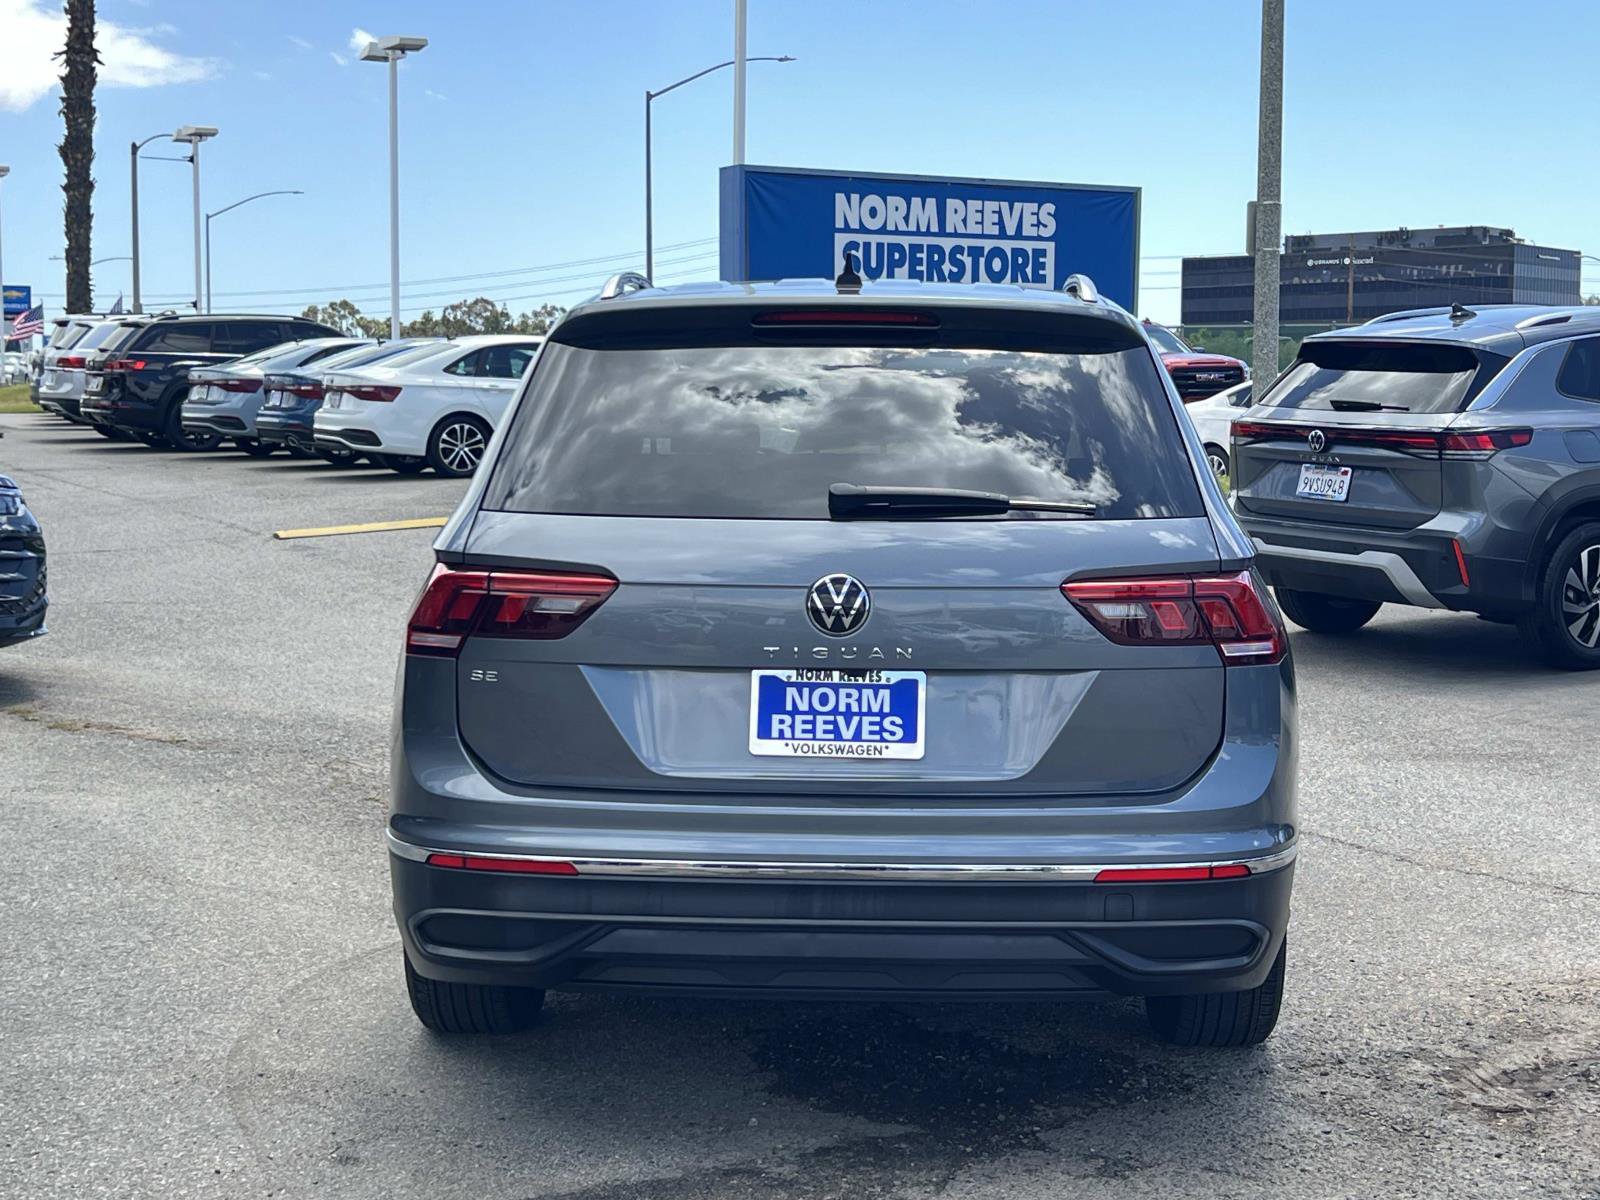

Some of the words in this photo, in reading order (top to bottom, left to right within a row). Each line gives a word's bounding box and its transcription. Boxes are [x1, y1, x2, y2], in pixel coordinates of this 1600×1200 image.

[835, 192, 939, 233] NORM
[946, 198, 1057, 238] REEVES
[842, 240, 1048, 284] SUPERSTORE
[1301, 476, 1345, 495] 9VSU948
[764, 647, 912, 659] TIGUAN
[470, 670, 498, 681] SE
[796, 669, 833, 682] NORM
[786, 687, 891, 713] NORM
[771, 714, 904, 741] REEVES
[791, 743, 883, 756] VOLKSWAGEN
